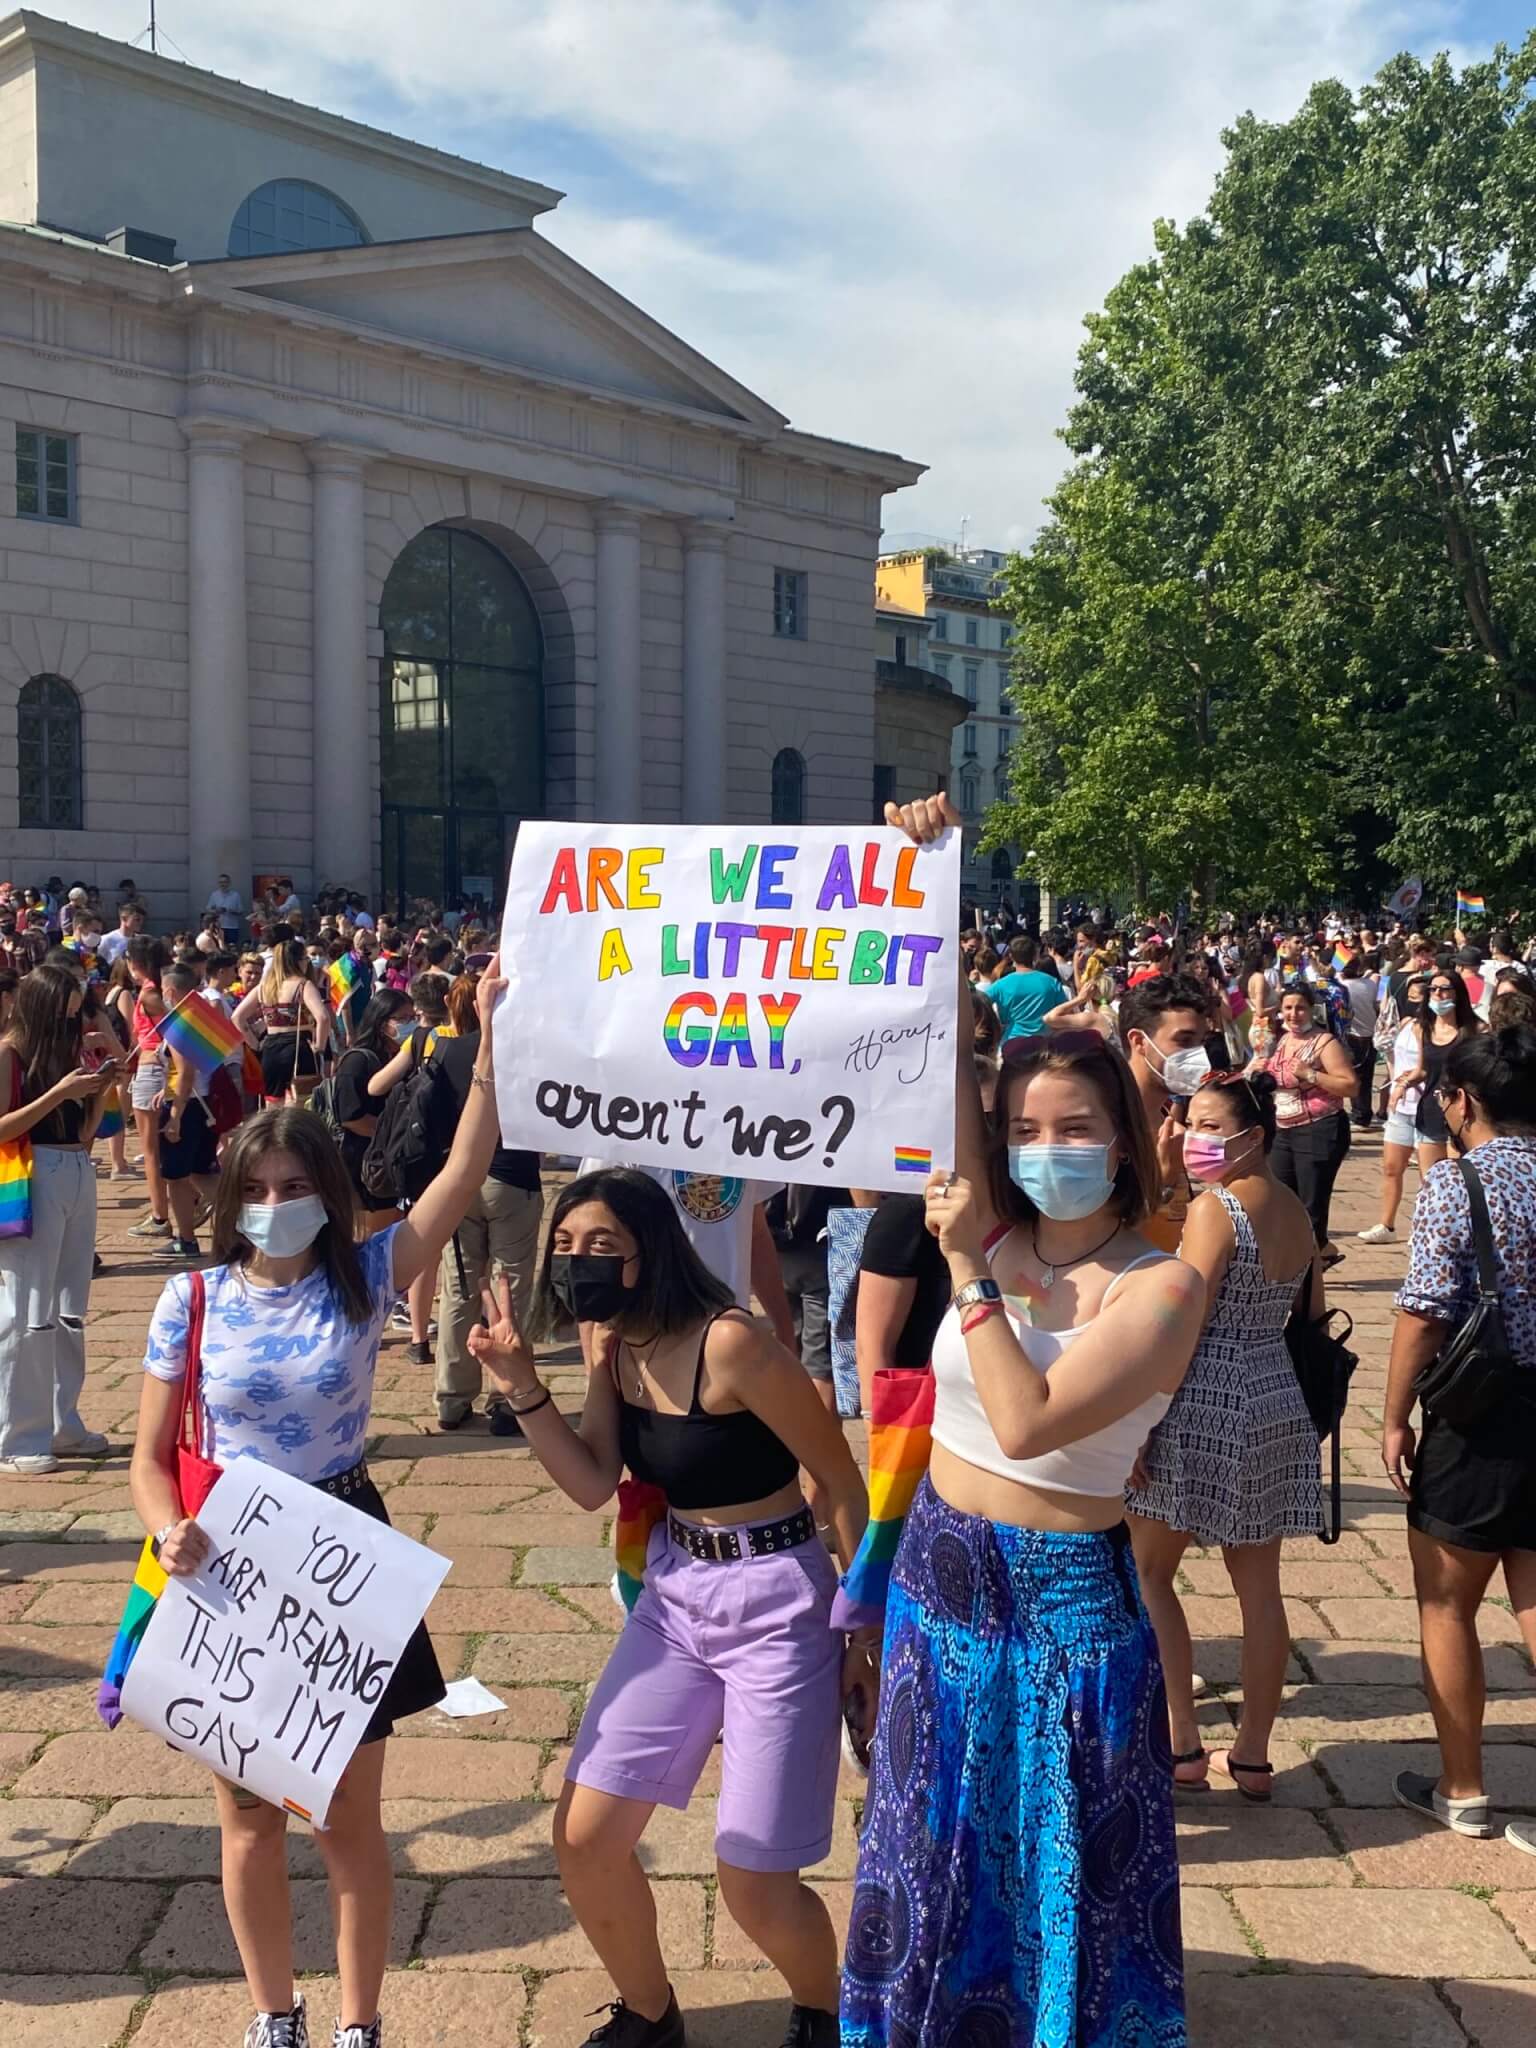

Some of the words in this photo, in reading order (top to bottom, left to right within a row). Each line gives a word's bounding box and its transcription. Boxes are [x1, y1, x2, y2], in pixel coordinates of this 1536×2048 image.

[540, 847, 664, 914] ARE
[709, 844, 798, 910] WE
[816, 842, 926, 909] ALL
[598, 927, 633, 981] A
[663, 991, 802, 1074] GAY,
[535, 1079, 706, 1149] aren't
[723, 1095, 856, 1169] we?
[230, 1485, 283, 1536] IF
[296, 1525, 377, 1607] YOU
[207, 1547, 268, 1614] ARE
[266, 1593, 393, 1705] READING
[179, 1595, 265, 1703] THIS
[273, 1684, 346, 1775] I'M
[164, 1697, 260, 1779] GAY
